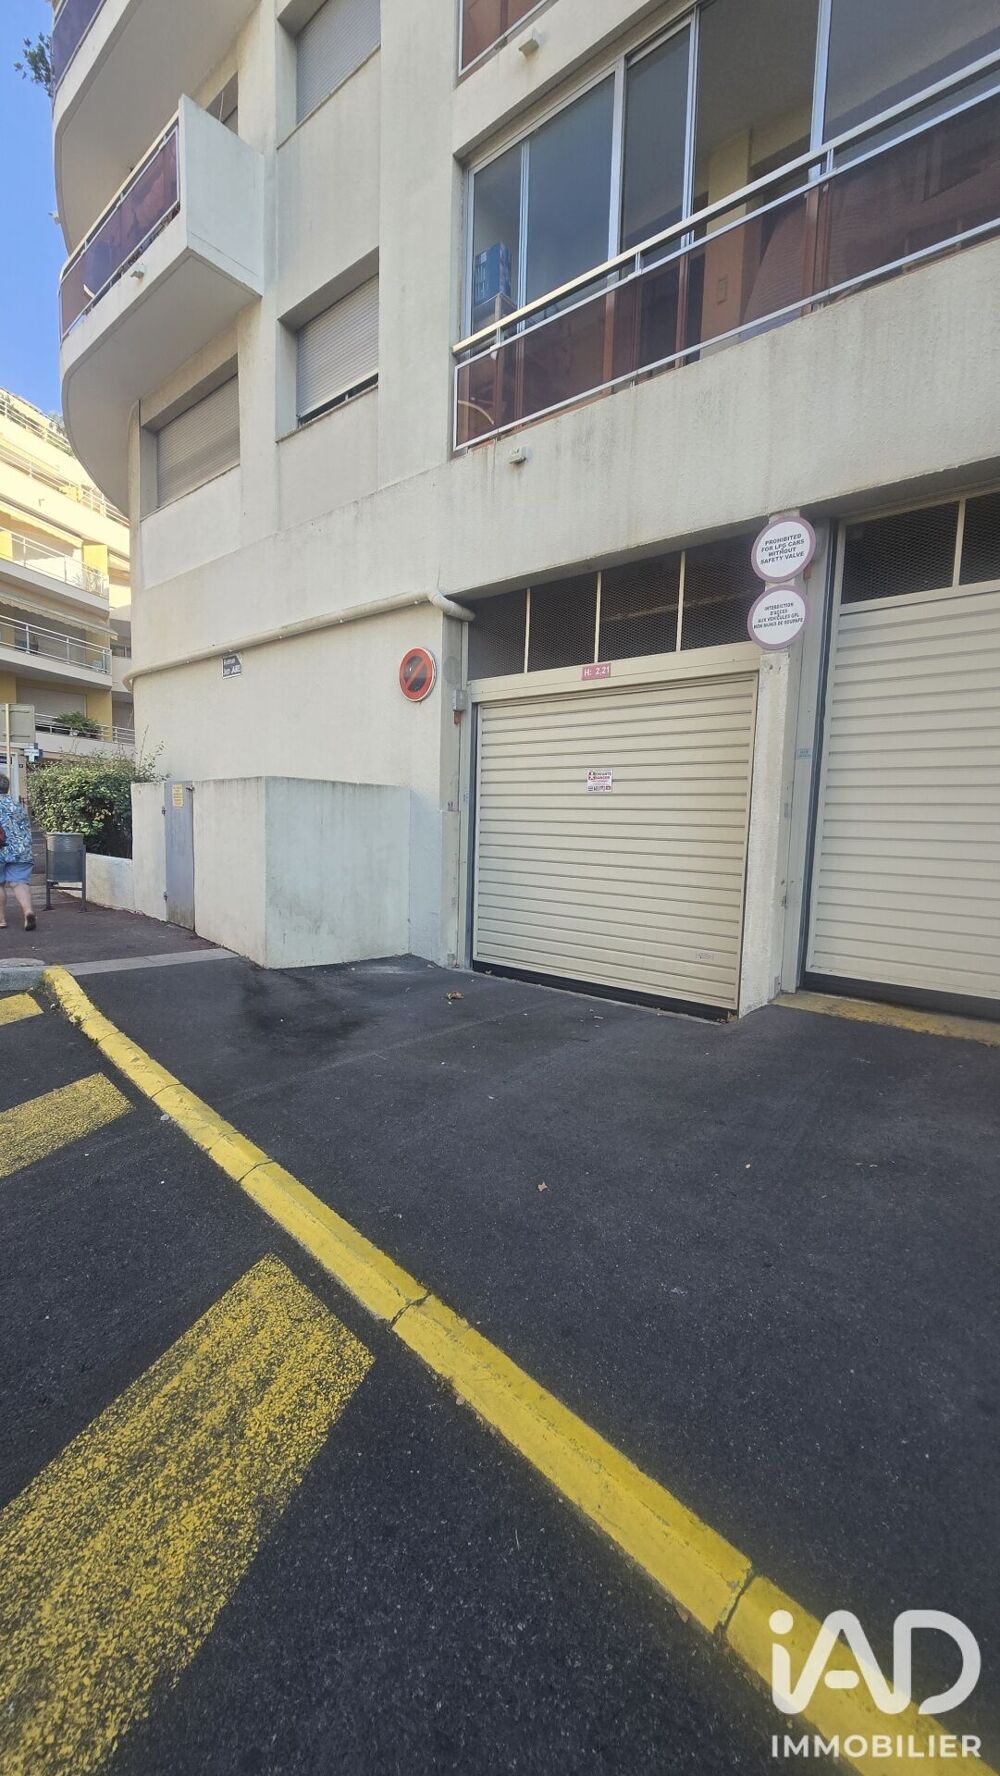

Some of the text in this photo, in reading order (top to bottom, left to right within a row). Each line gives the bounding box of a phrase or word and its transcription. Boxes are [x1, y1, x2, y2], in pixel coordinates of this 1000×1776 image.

[761, 538, 805, 553] FOR LPG CARS
[765, 533, 802, 546] PROHIBITED
[760, 550, 805, 564] SAFETY VALVE
[768, 546, 796, 557] WITHOUT
[764, 602, 794, 611] INTERDICTION
[584, 668, 592, 677] H:
